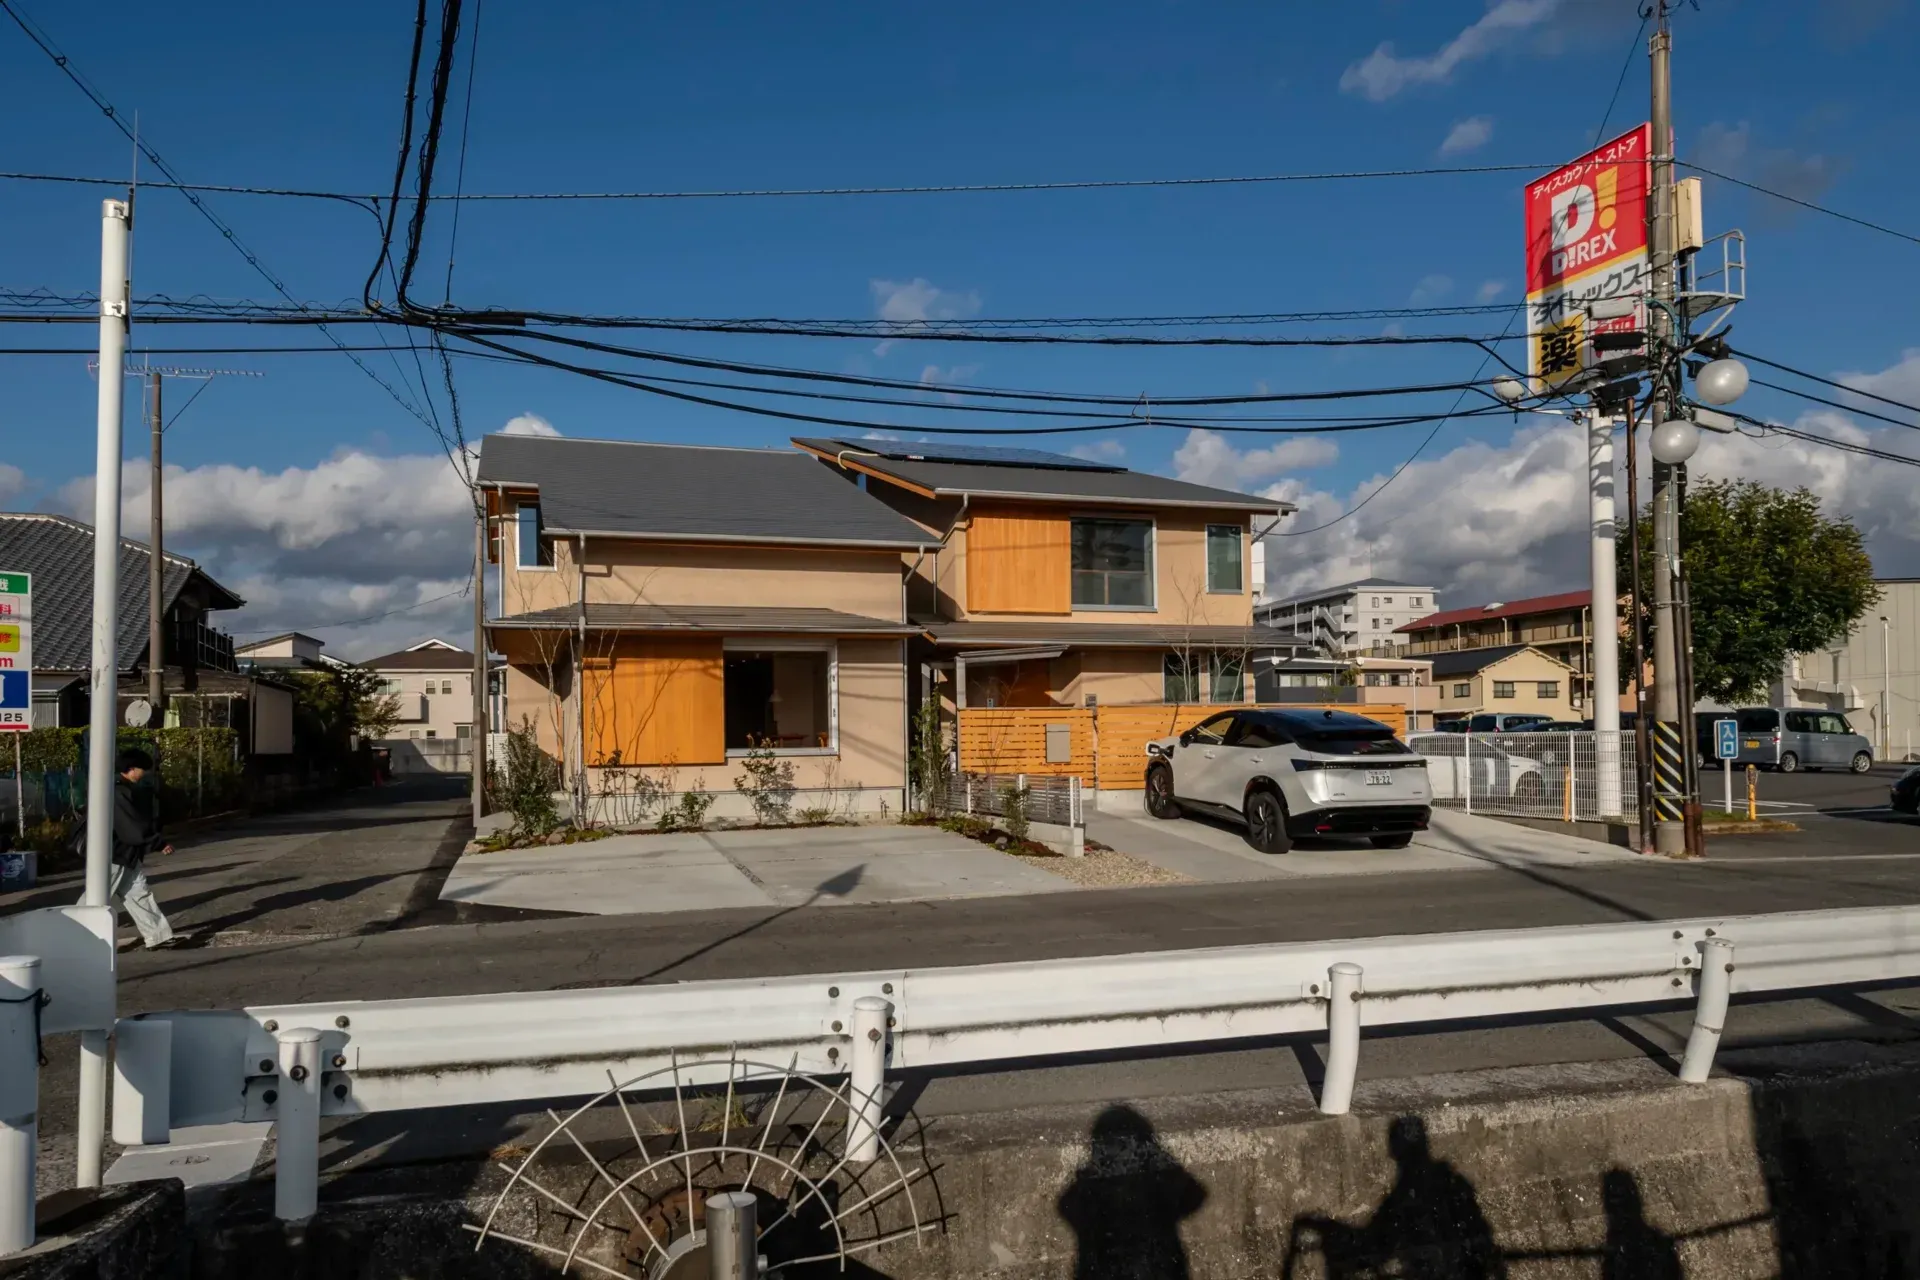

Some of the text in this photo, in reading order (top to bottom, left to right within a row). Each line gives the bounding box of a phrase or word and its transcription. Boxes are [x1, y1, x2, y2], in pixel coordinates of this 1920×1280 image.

[1552, 228, 1617, 276] D!REX
[1533, 263, 1643, 325] ダイレックス
[1541, 325, 1577, 374] 薬
[1723, 724, 1734, 755] 入口
